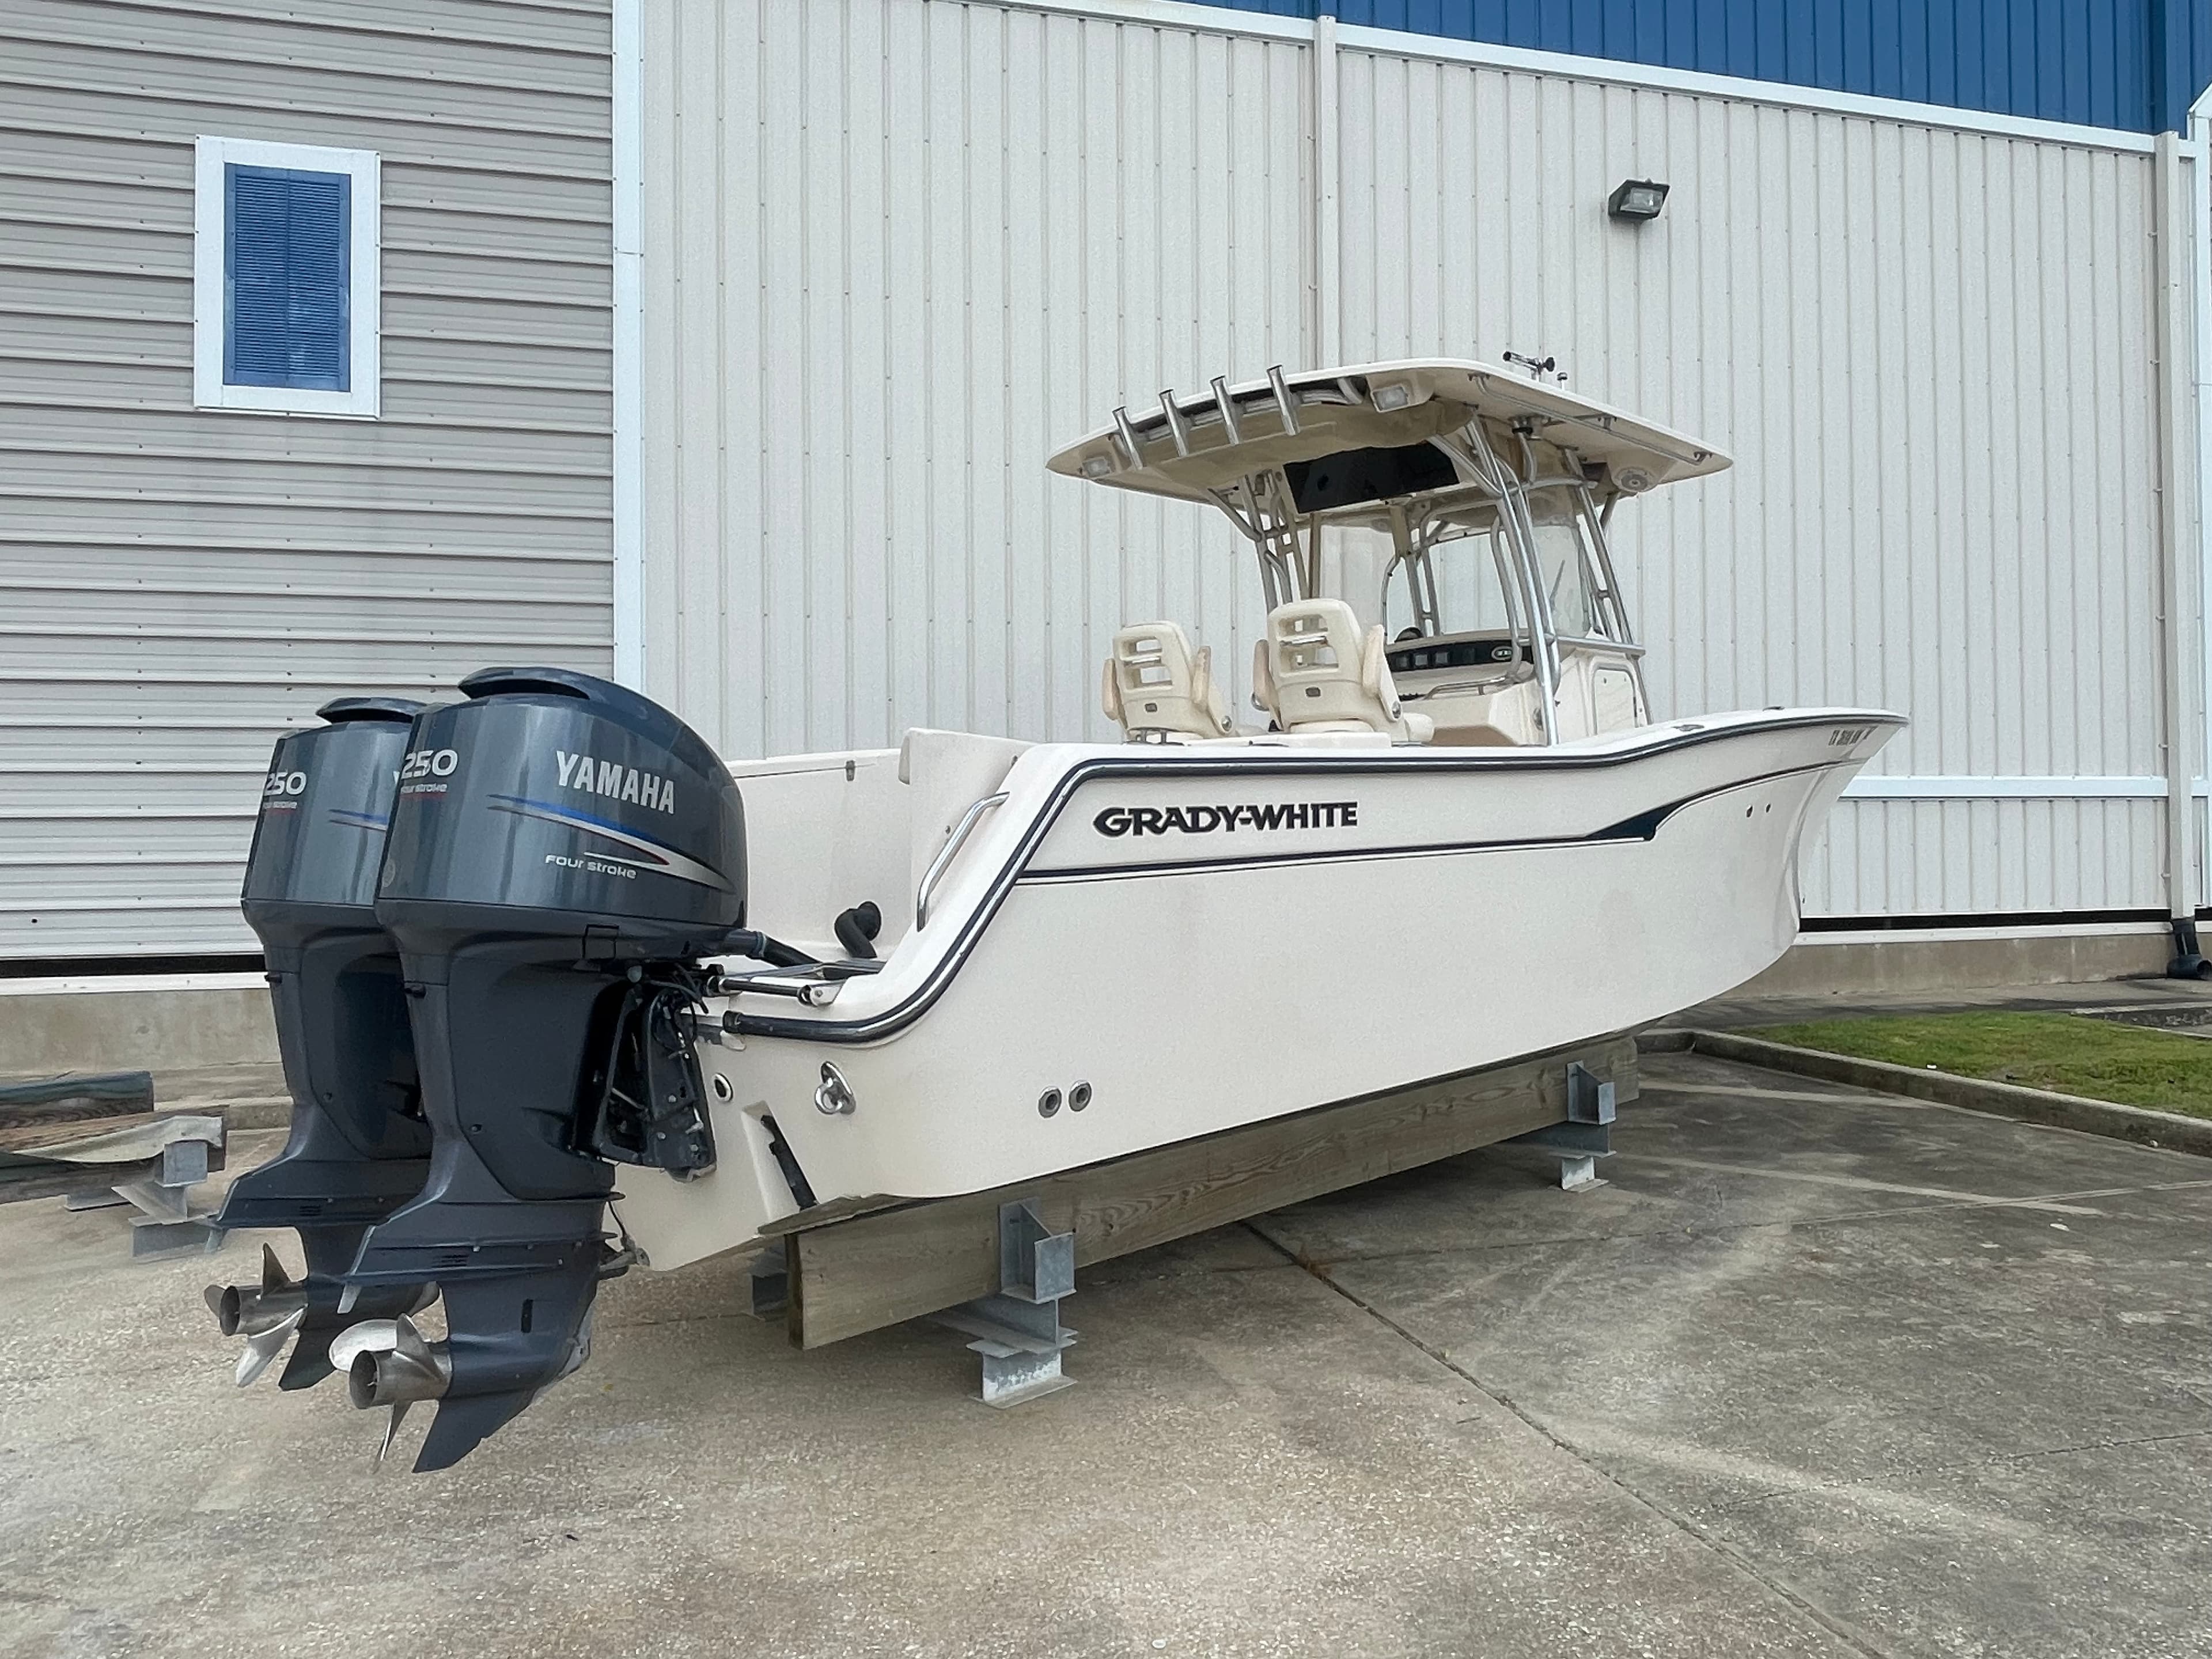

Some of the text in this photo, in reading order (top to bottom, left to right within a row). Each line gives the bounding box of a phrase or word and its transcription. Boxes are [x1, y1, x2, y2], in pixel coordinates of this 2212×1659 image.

[402, 749, 457, 778] 250
[556, 751, 674, 814] YAMAHA
[1094, 801, 1358, 836] GRADY-WHITE
